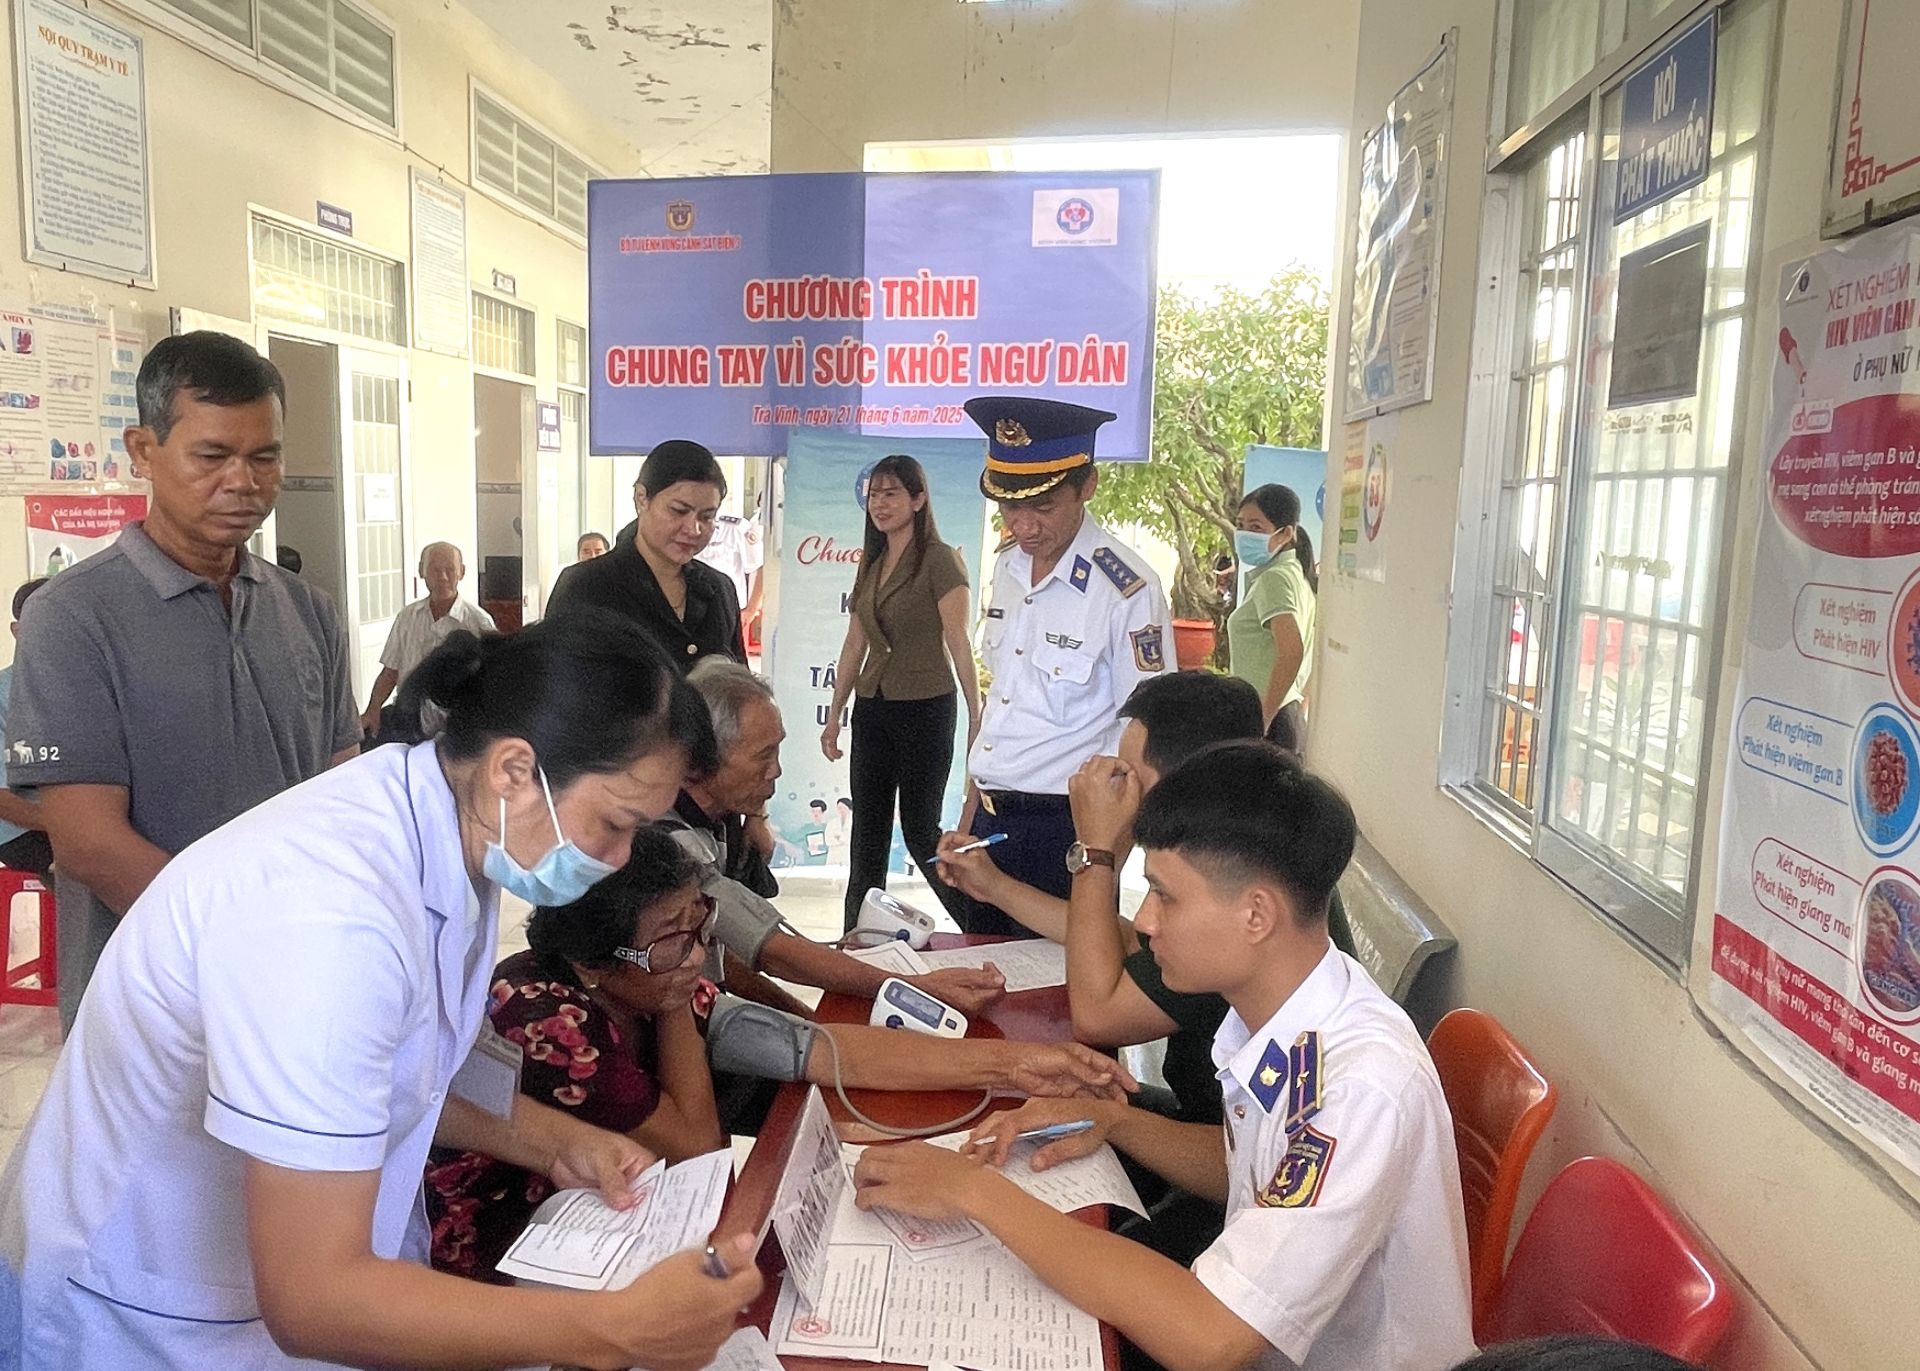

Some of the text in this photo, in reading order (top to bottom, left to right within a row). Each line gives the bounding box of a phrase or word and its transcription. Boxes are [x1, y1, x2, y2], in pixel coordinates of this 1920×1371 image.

[58, 35, 79, 53] QUY
[1652, 55, 1677, 123] NƠI
[1619, 99, 1705, 209] PHÁT THUỐC
[745, 271, 977, 318] CHƯƠNG TRÌNH
[1826, 280, 1852, 313] XÉT
[1854, 262, 1911, 305] NGHIỆM
[1852, 305, 1883, 342] VIÊM
[1884, 298, 1916, 334] GAN
[607, 331, 1127, 386] CHUNG TAY VÌ SỨC KHỎE NGƯ DÂN
[1864, 356, 1888, 382] PHỤ
[1890, 346, 1914, 375] NỮ
[753, 406, 770, 424] Trà
[804, 405, 833, 426] ngày
[836, 407, 851, 423] 21
[854, 404, 887, 426] tháng
[891, 407, 901, 423] 6
[903, 404, 929, 424] năm
[933, 406, 963, 424] 2025
[1863, 452, 1885, 472] gan
[1886, 447, 1897, 464] B
[1899, 445, 1915, 464] và
[1854, 476, 1892, 500] phòng
[1893, 475, 1920, 495] trán
[1852, 506, 1877, 528] phát
[1878, 505, 1906, 529] hiện
[1819, 598, 1877, 627] Xét nghiệm
[1813, 628, 1881, 658] Phát hiện HIV
[39, 745, 60, 761] 92
[1766, 714, 1824, 748] Xét nghiệm
[1742, 735, 1844, 787] Phát hiện viêm gan B
[1775, 851, 1835, 897] Xét nghiệm
[1754, 869, 1854, 940] Phát hiện giang mai
[1791, 972, 1807, 989] nữ
[1807, 982, 1833, 1012] mang
[1866, 1024, 1891, 1049] đến
[1893, 1039, 1911, 1058] cơ
[1790, 994, 1809, 1021] HIV,
[1810, 1010, 1832, 1034] viêm
[1847, 1036, 1855, 1052] B
[1856, 1045, 1870, 1065] và
[1871, 1055, 1908, 1090] giang
